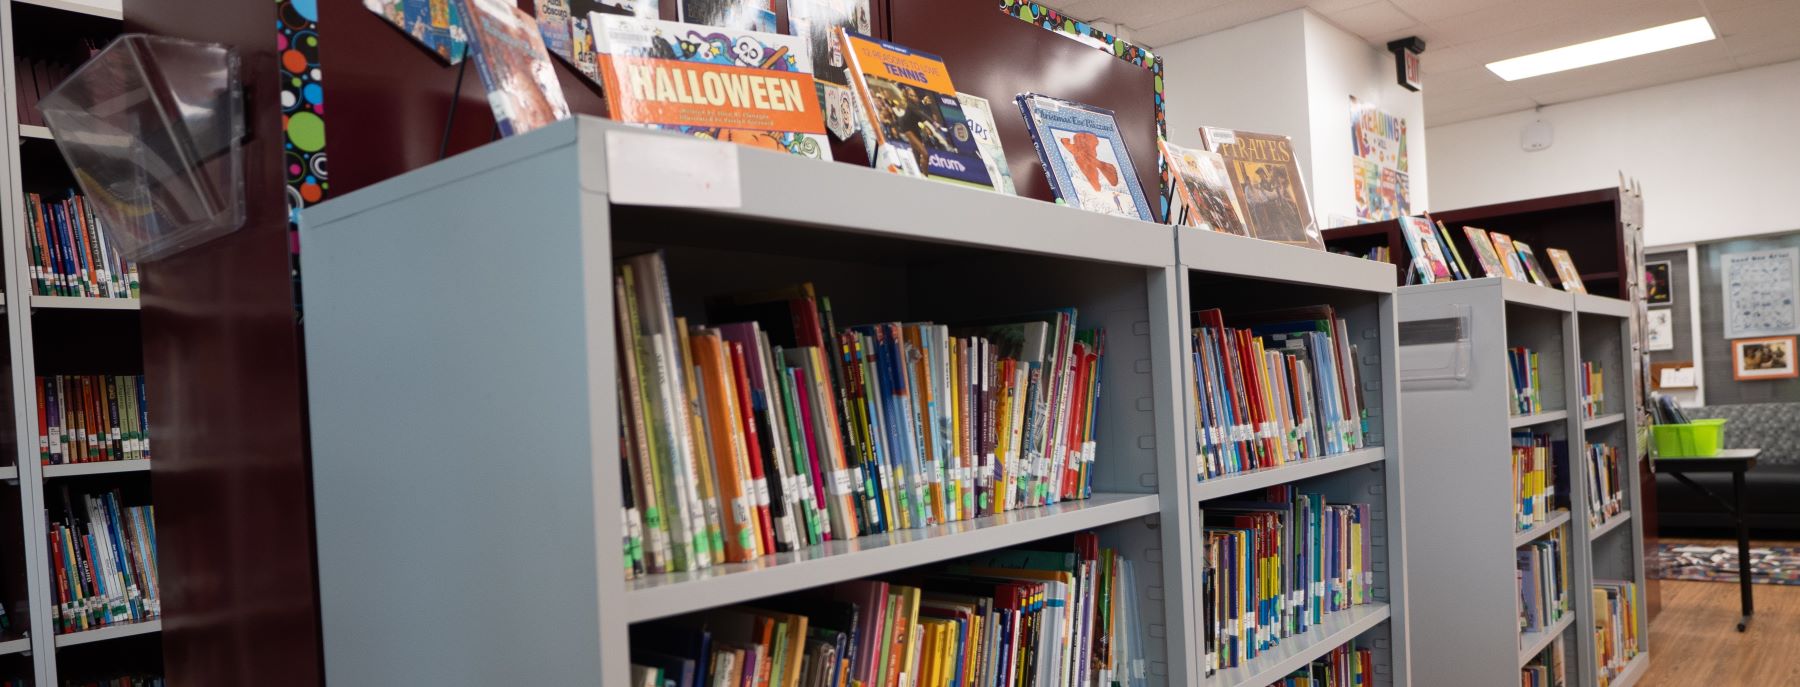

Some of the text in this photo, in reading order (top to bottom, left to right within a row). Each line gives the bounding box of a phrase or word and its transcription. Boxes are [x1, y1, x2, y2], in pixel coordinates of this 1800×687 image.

[883, 62, 928, 84] TENNIS
[629, 63, 805, 113] HALLOWEEN
[1221, 136, 1291, 162] PIRATES
[928, 152, 962, 172] ctrum
